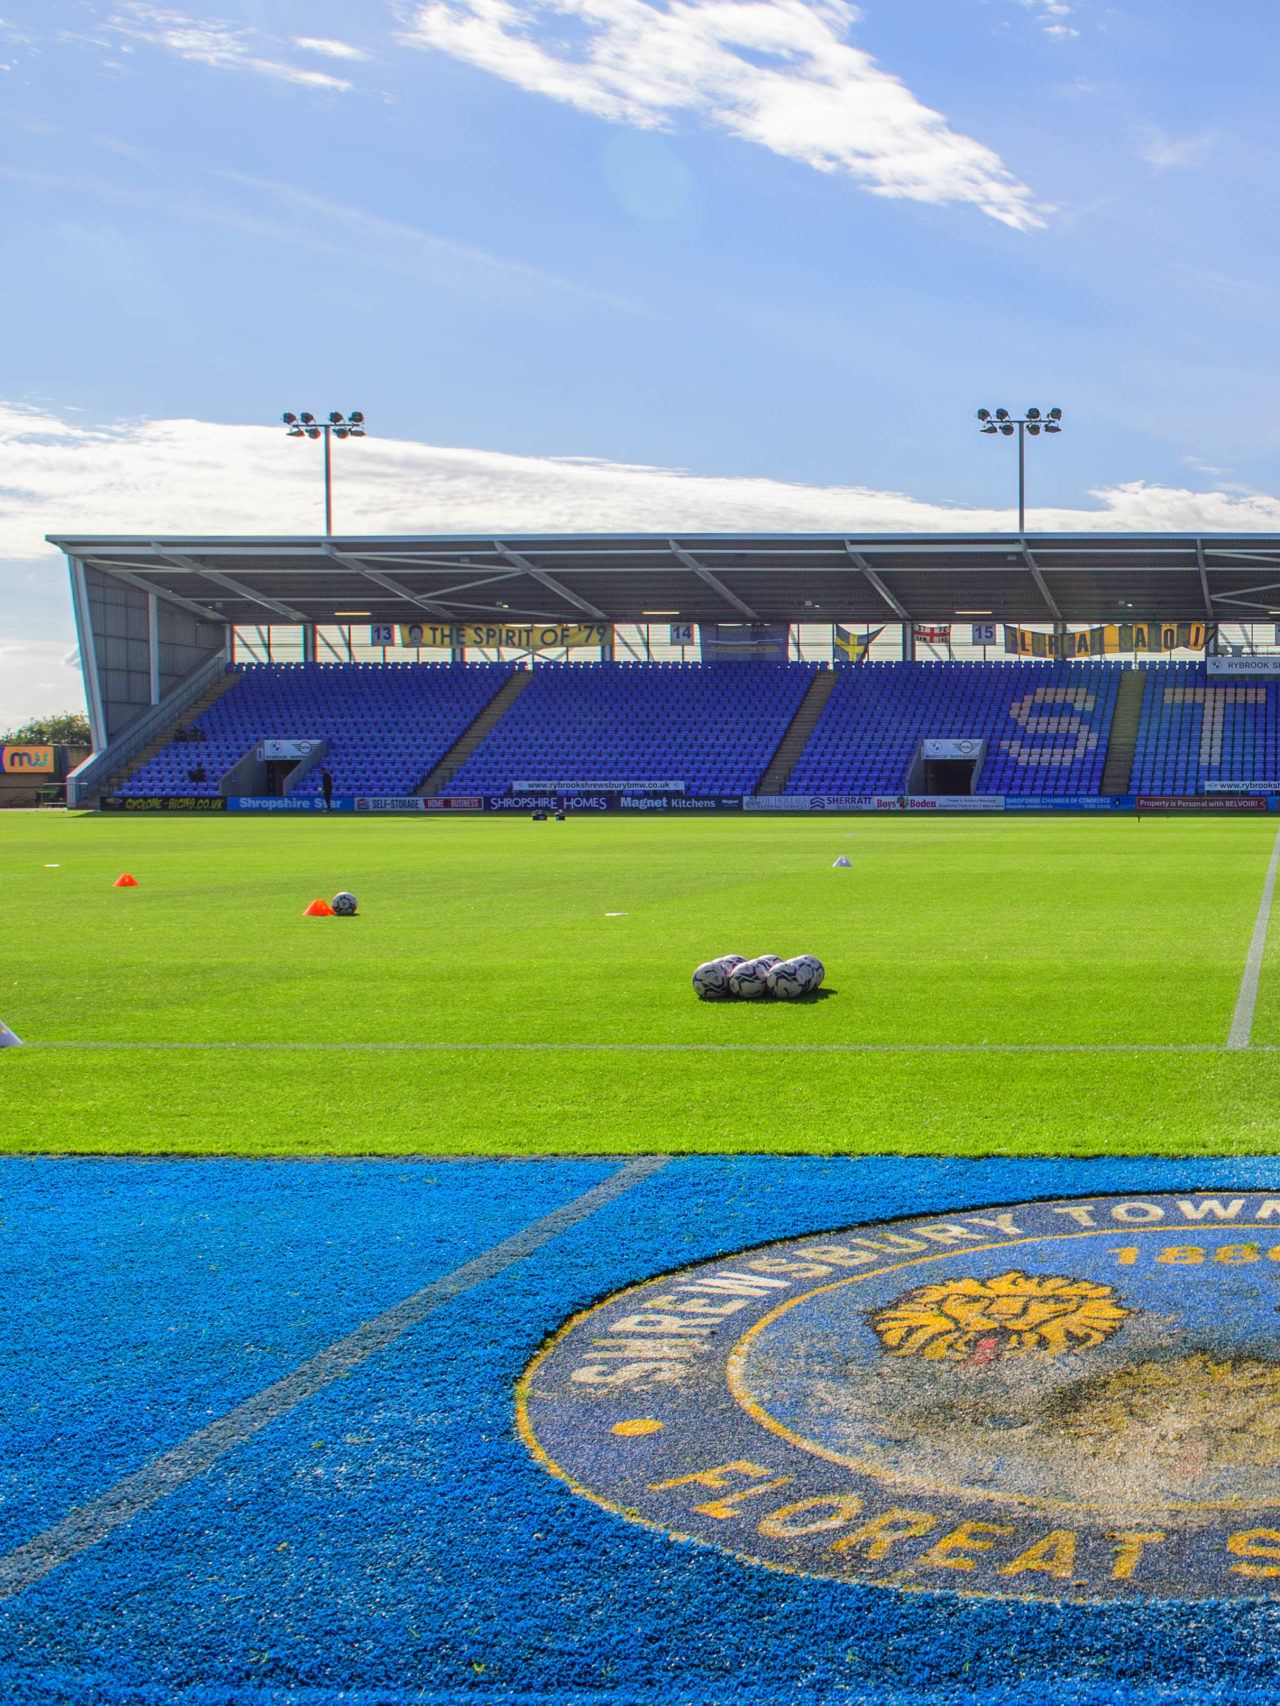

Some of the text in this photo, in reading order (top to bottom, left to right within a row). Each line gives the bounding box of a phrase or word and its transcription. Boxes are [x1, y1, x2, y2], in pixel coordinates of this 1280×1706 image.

[374, 626, 392, 641] 13
[429, 624, 607, 647] THE SPIRIT OF '79
[673, 625, 692, 640] 14
[974, 625, 994, 640] 15
[1228, 661, 1269, 669] RYBROOK
[240, 798, 310, 810] Shropshire
[373, 799, 479, 809] SELF-STORAGE HOME BUSINESS
[490, 797, 607, 810] SHROPSHIRE HOMES
[620, 797, 716, 810] Magnet Kitchens
[826, 796, 873, 805] SHERRATT
[876, 799, 897, 809] Boys
[909, 799, 937, 808] Boden
[1139, 799, 1258, 809] Property is Personal with BELVOIR!
[571, 1213, 1024, 1386] SHREWSBURY
[646, 1459, 1167, 1581] FLOREAT
